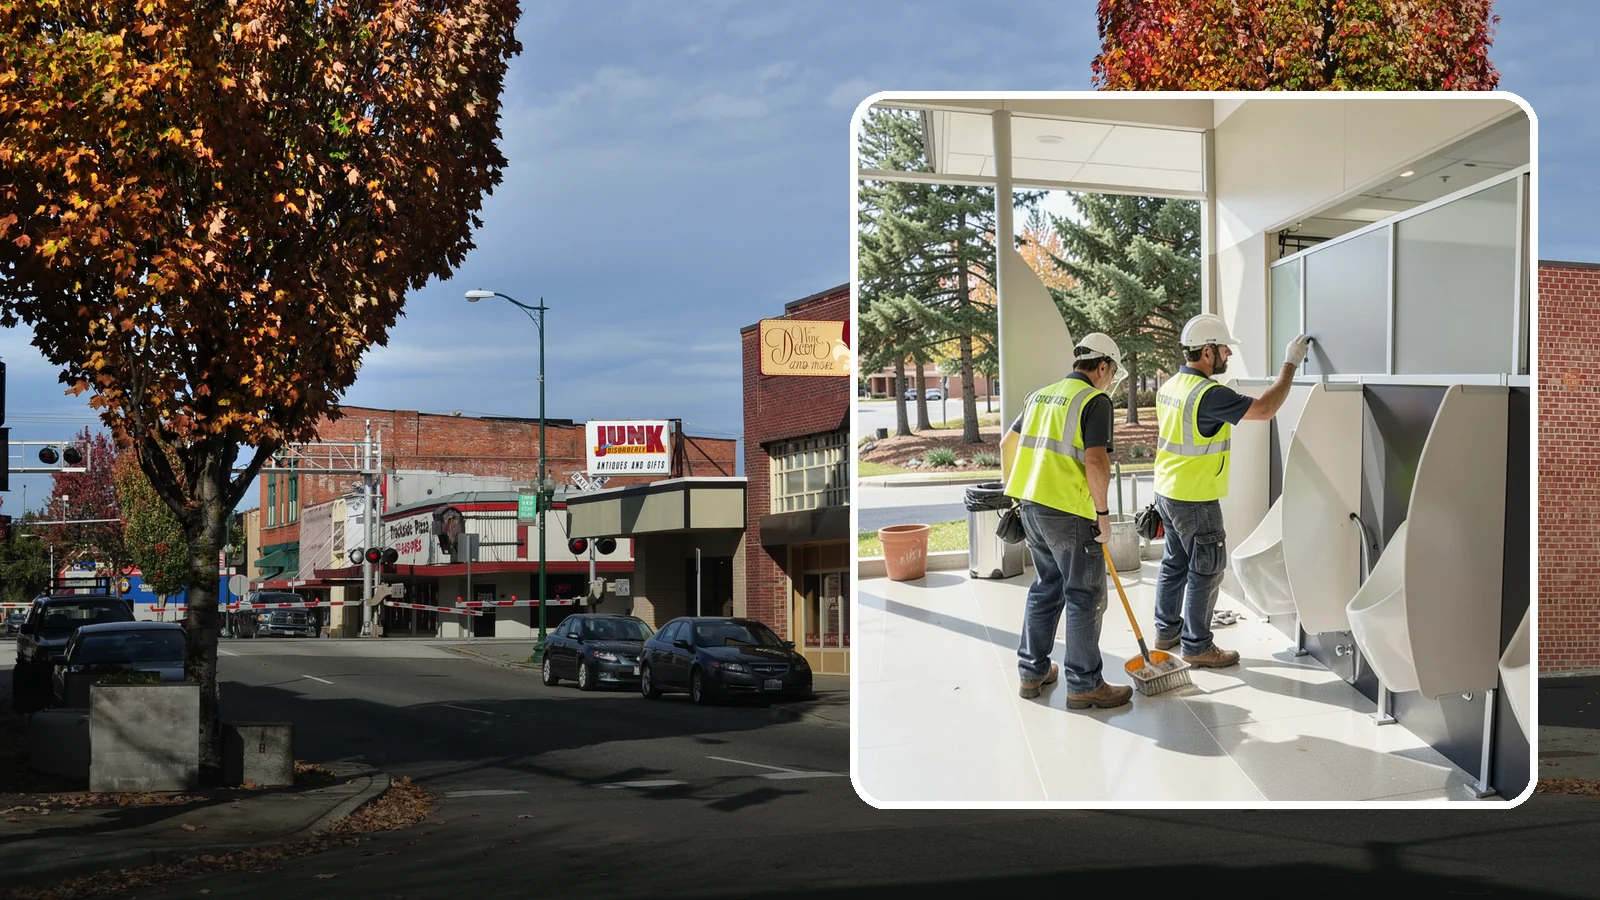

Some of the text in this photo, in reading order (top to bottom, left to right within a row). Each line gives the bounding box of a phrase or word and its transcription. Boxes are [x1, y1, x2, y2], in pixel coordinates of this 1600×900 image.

[765, 328, 830, 366] Decor
[595, 425, 665, 457] JUNK
[607, 446, 646, 454] DISORDERLY
[597, 460, 665, 470] ANTIQUES AND GIFTS
[414, 519, 429, 535] Pizza
